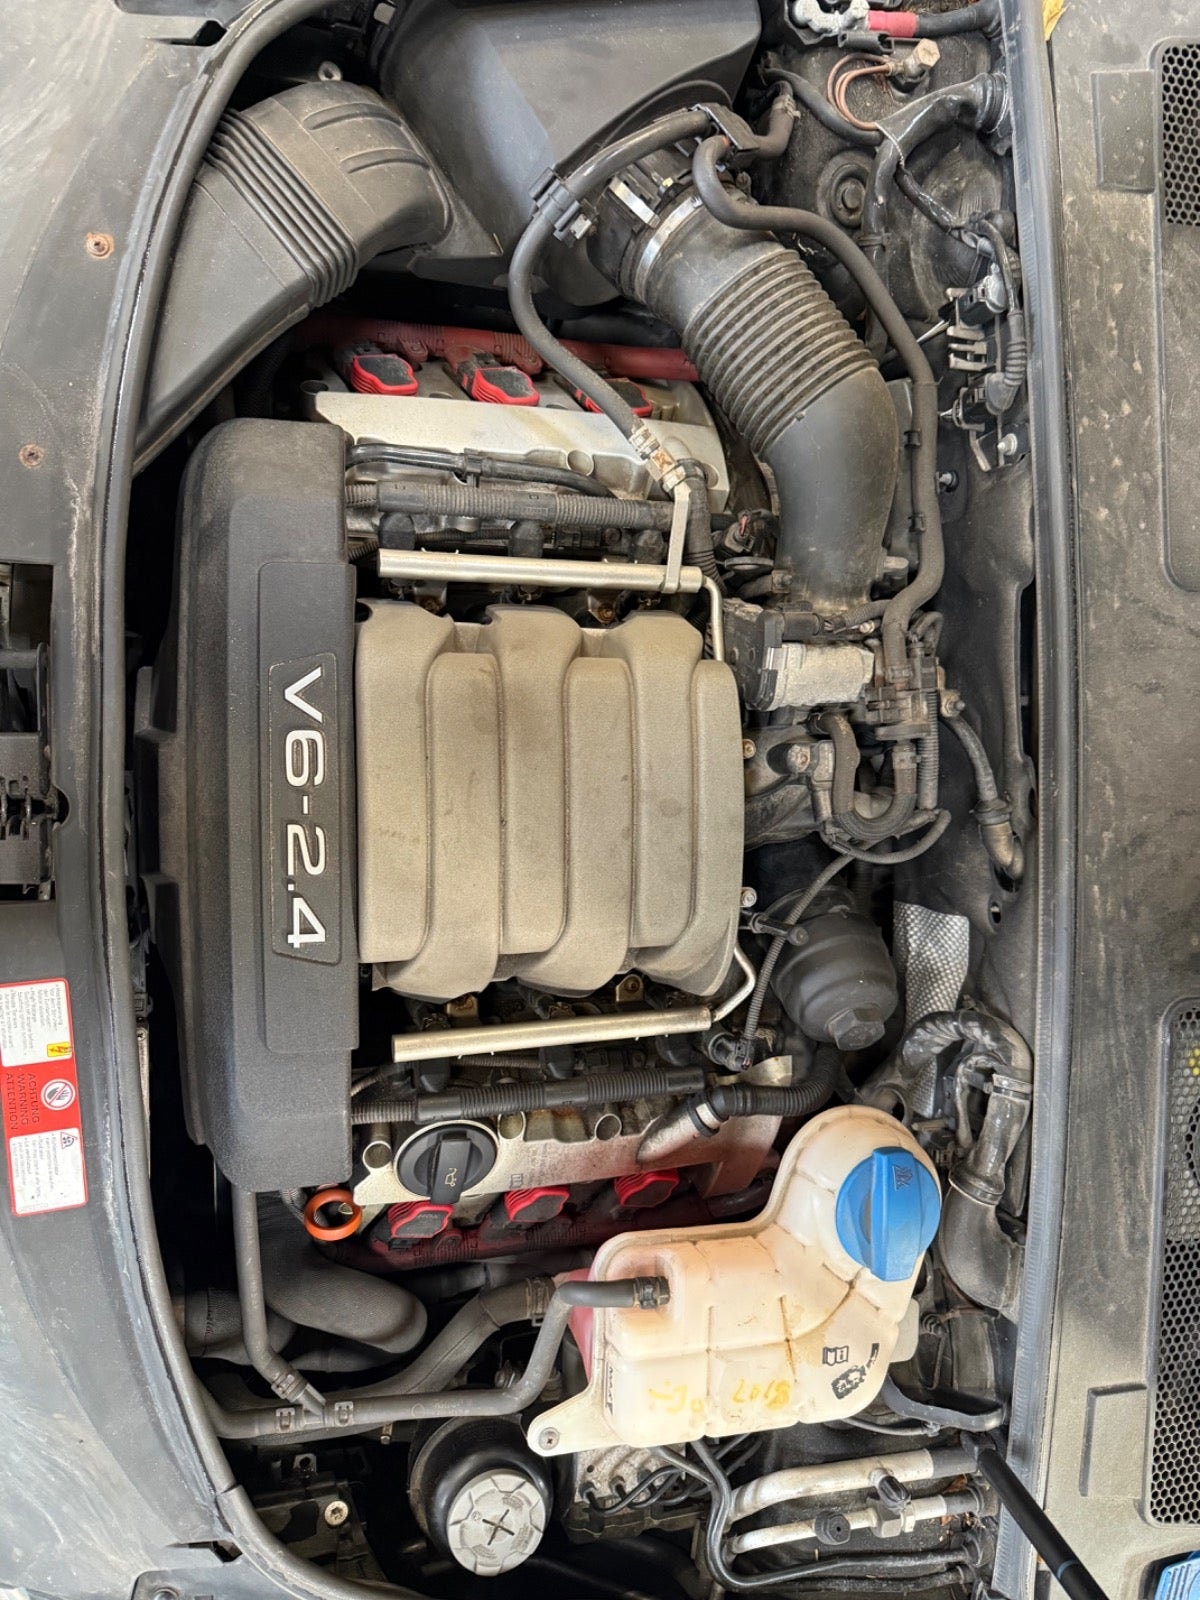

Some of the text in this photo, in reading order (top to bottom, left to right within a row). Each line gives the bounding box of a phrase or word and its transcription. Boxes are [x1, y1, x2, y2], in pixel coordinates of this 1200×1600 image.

[284, 665, 327, 949] V6-2.4
[6, 1073, 18, 1130] ATTENTION
[17, 1073, 28, 1125] WARNING
[28, 1073, 40, 1123] ACHTUNG
